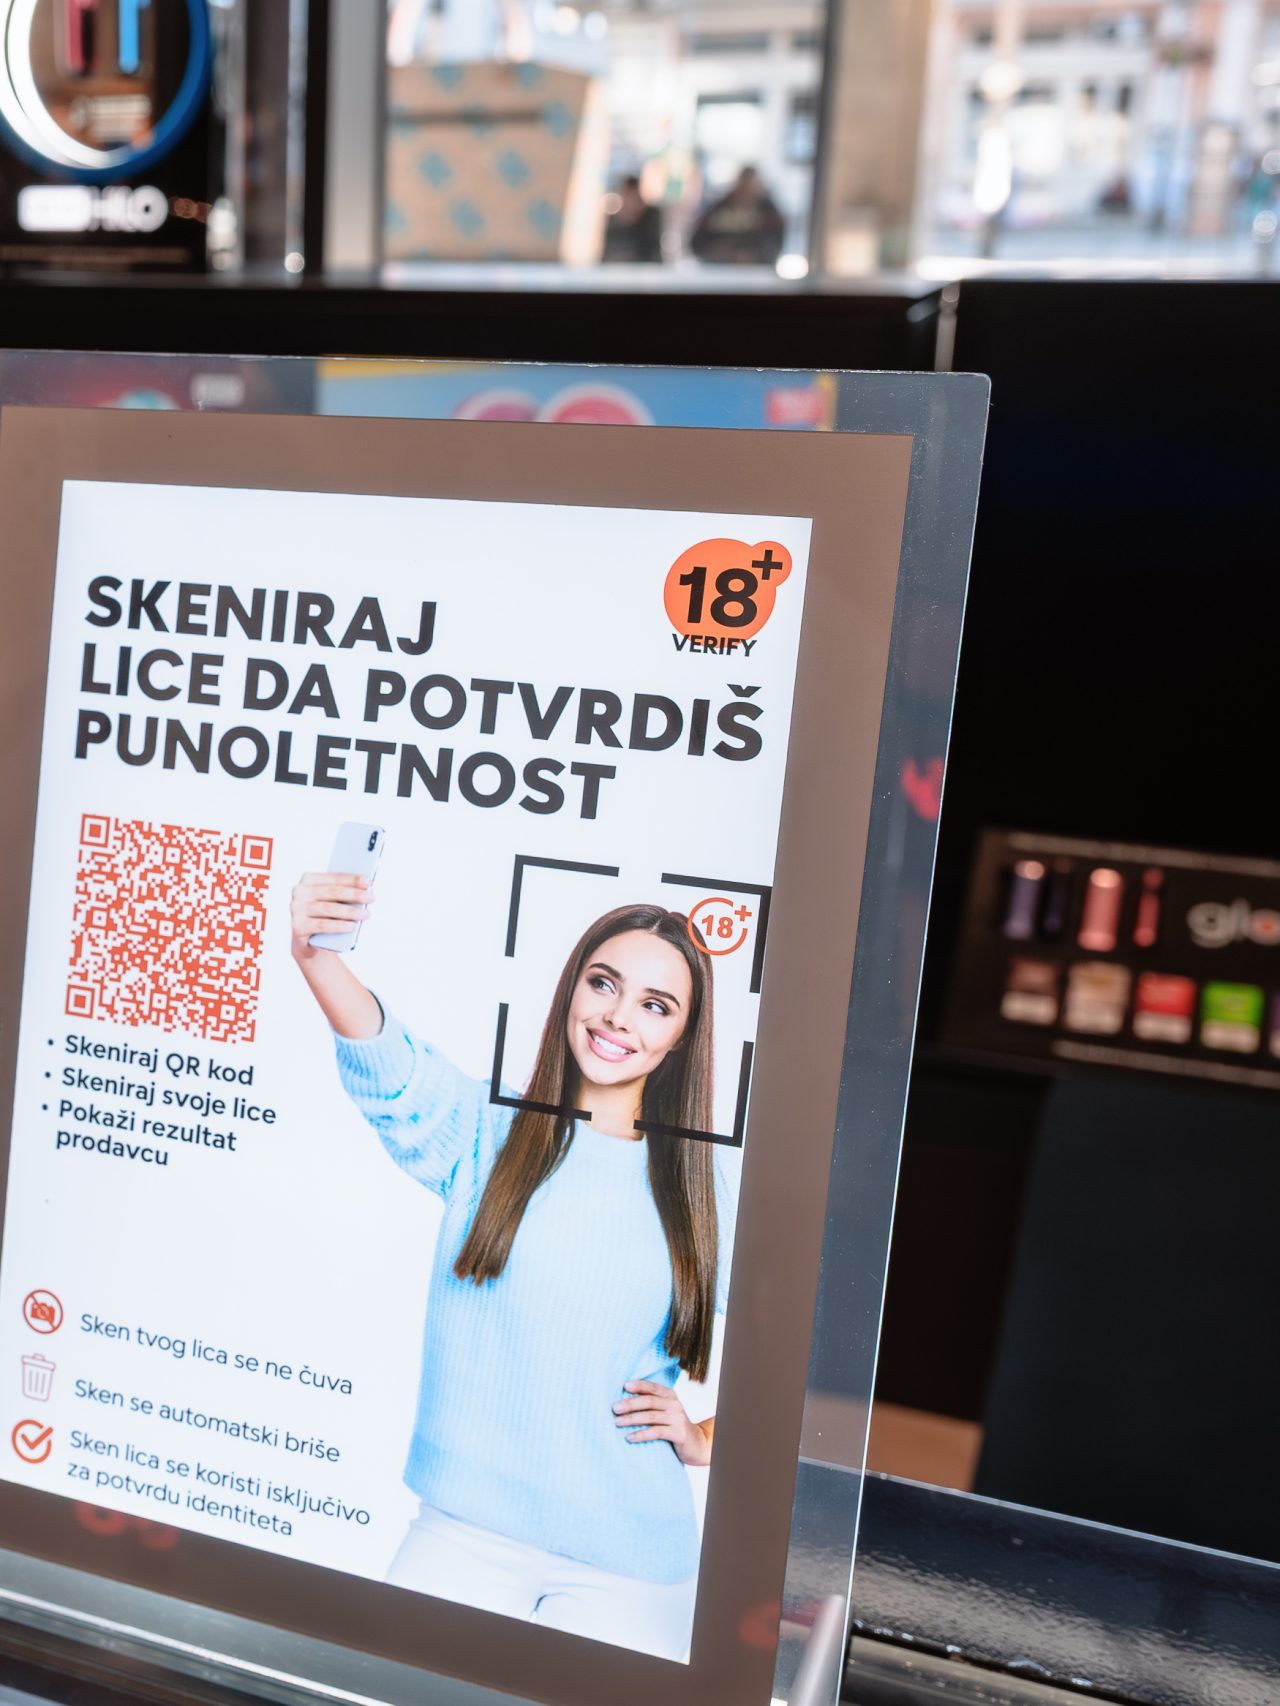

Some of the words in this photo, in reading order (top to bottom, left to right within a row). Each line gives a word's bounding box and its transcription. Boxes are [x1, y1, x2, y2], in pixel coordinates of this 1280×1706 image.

[84, 575, 437, 656] SKENIRAJ
[679, 550, 783, 628] 18+
[672, 633, 757, 657] VERIFY
[80, 642, 224, 706] LICE
[243, 657, 340, 719] DA
[363, 668, 764, 761] POTVRDIŠ
[74, 708, 617, 820] PUNOLETNOST
[701, 905, 752, 939] 18+
[62, 1067, 155, 1106] Skeniraj
[162, 1090, 226, 1117] svoje
[233, 1097, 276, 1124] lice
[65, 1034, 158, 1073] Skeniraj
[166, 1053, 200, 1078] QR
[208, 1059, 254, 1086] kod
[56, 1130, 168, 1166] prodavcu
[59, 1099, 135, 1131] Pokaži
[142, 1120, 237, 1151] rezultat
[81, 1314, 130, 1341] Sken
[137, 1327, 186, 1359] tvog
[192, 1339, 228, 1365] lica
[235, 1354, 259, 1372] se
[265, 1361, 292, 1380] ne
[299, 1365, 352, 1395] čuva
[75, 1379, 124, 1407] Sken
[130, 1397, 153, 1415] se
[159, 1404, 278, 1447] automatski
[285, 1432, 340, 1462] briše
[67, 1463, 90, 1480] za
[96, 1471, 180, 1505] potvrdu
[187, 1490, 293, 1537] identiteta
[70, 1430, 119, 1459] Sken
[125, 1444, 159, 1469] lica
[166, 1459, 190, 1477] se
[196, 1462, 260, 1496] koristi
[267, 1481, 370, 1525] isključivo
